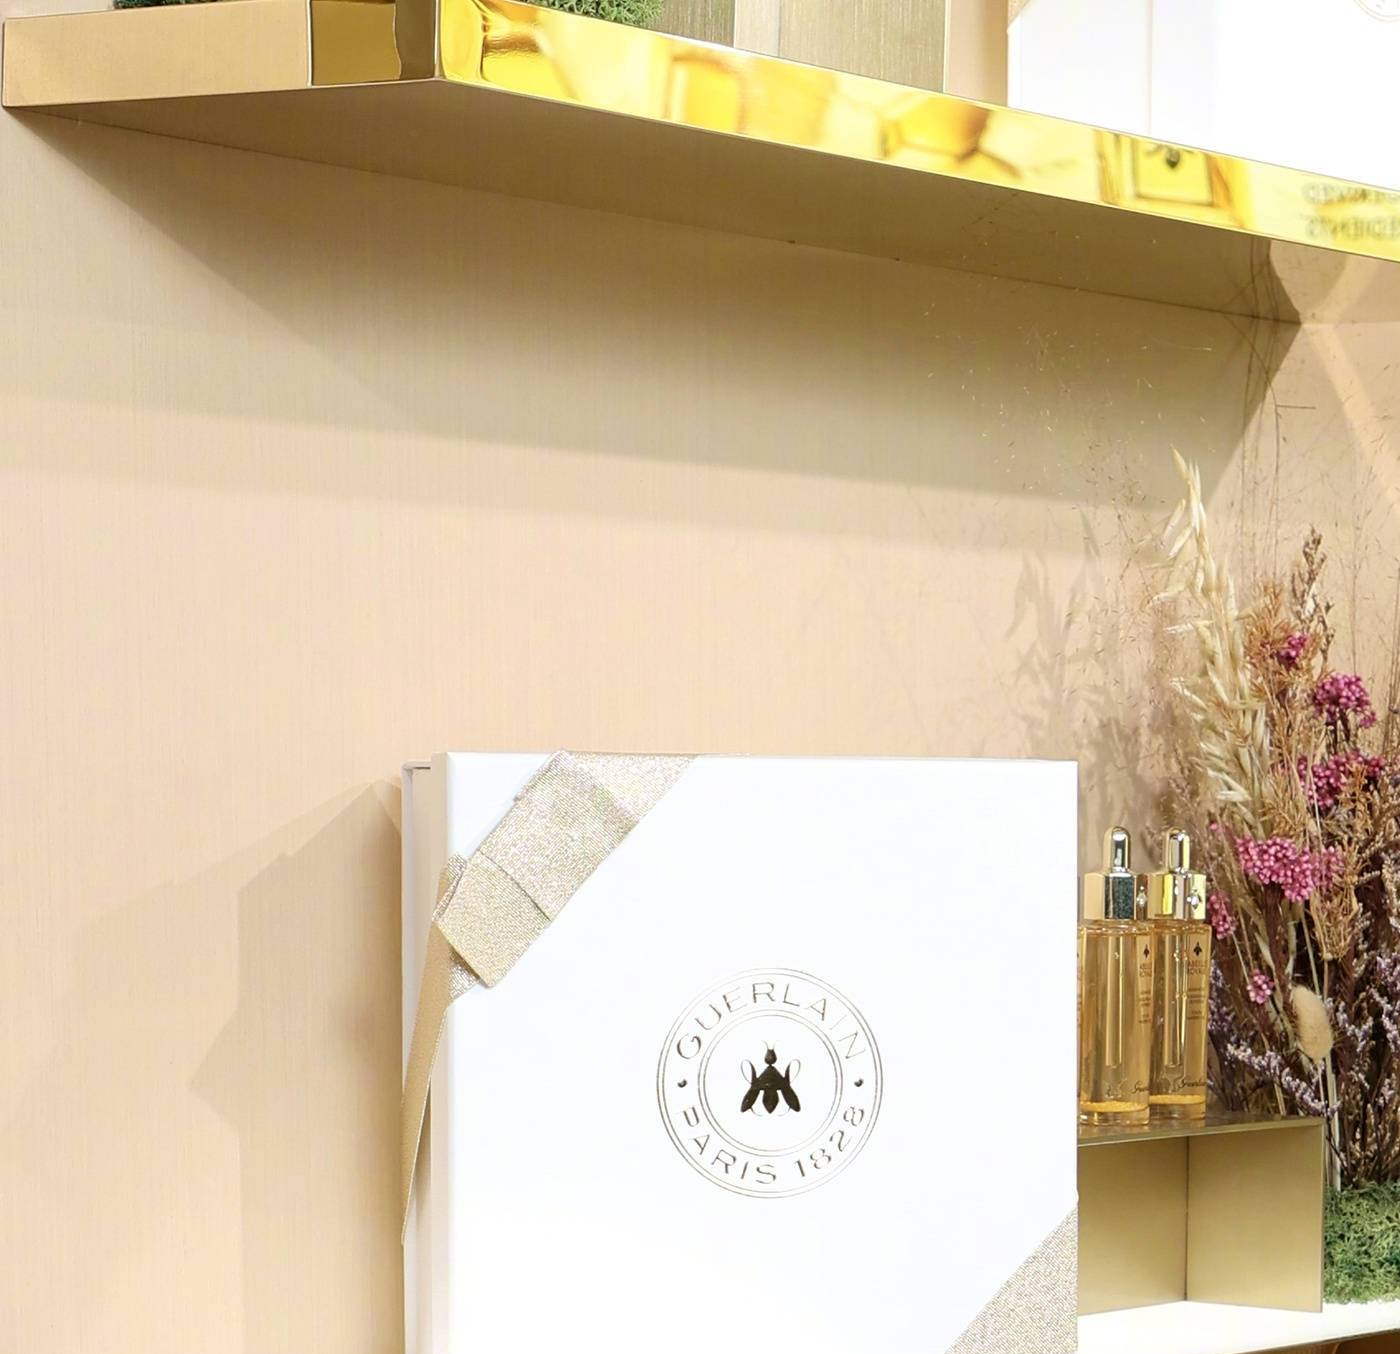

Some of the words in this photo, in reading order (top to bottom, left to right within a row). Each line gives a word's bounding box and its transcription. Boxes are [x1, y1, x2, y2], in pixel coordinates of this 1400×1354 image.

[676, 981, 866, 1060] GUERLAIN
[678, 1106, 776, 1184] PARIS
[794, 1106, 865, 1178] 1828
